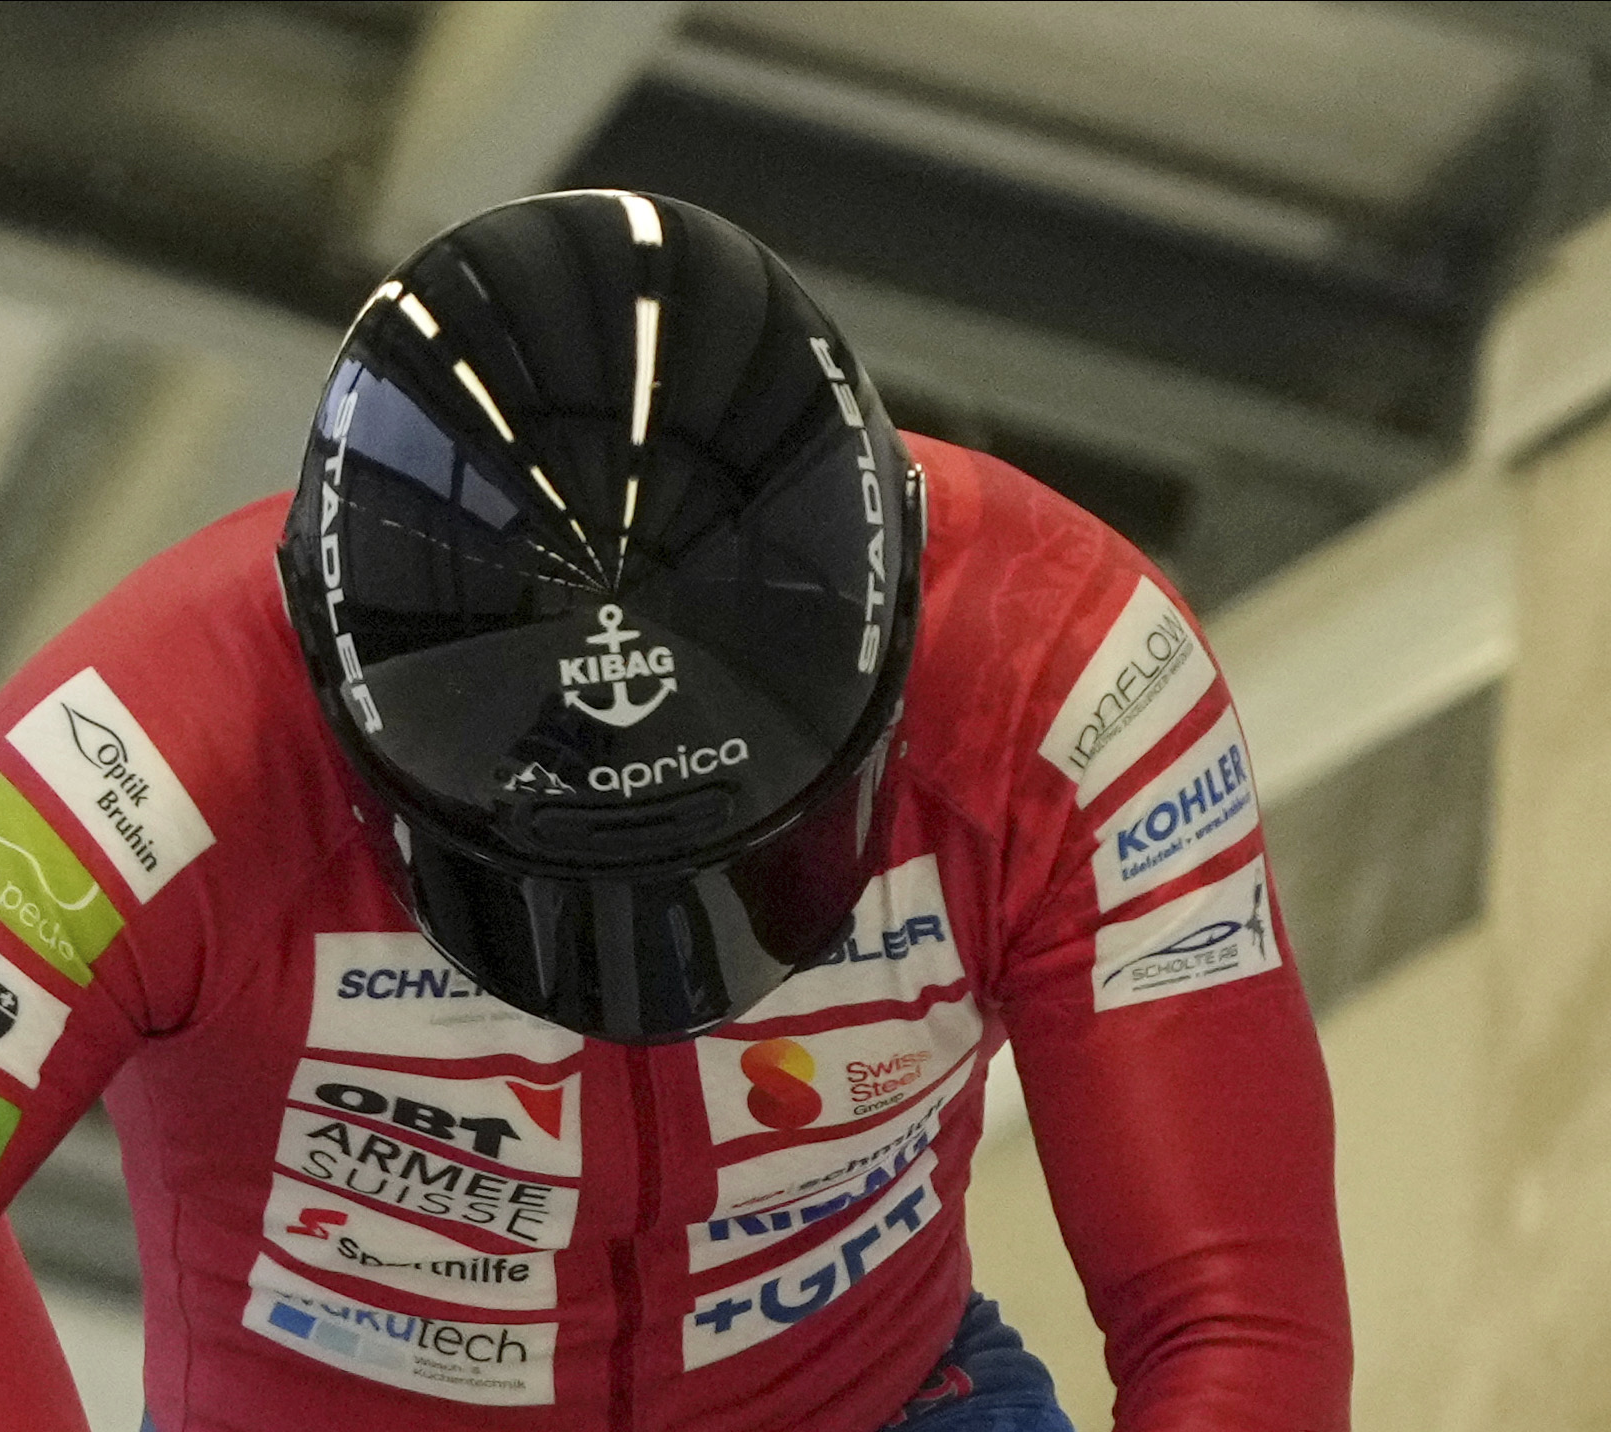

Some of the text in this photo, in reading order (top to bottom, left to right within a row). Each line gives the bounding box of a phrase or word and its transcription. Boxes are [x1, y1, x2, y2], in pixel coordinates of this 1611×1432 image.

[810, 336, 899, 675] STADLER
[317, 391, 384, 735] STADLER
[559, 645, 676, 687] KIBAG
[96, 742, 151, 809] Optik
[589, 736, 749, 798] aprica
[1117, 743, 1248, 861] KOHLER
[96, 790, 158, 873] Bruhin
[846, 1050, 931, 1083] Swiss
[850, 1067, 924, 1104] Steel
[853, 1092, 905, 1117] Group
[315, 1083, 521, 1159] OBT
[302, 1150, 548, 1241] SUISSE
[306, 1121, 552, 1207] ARMEE
